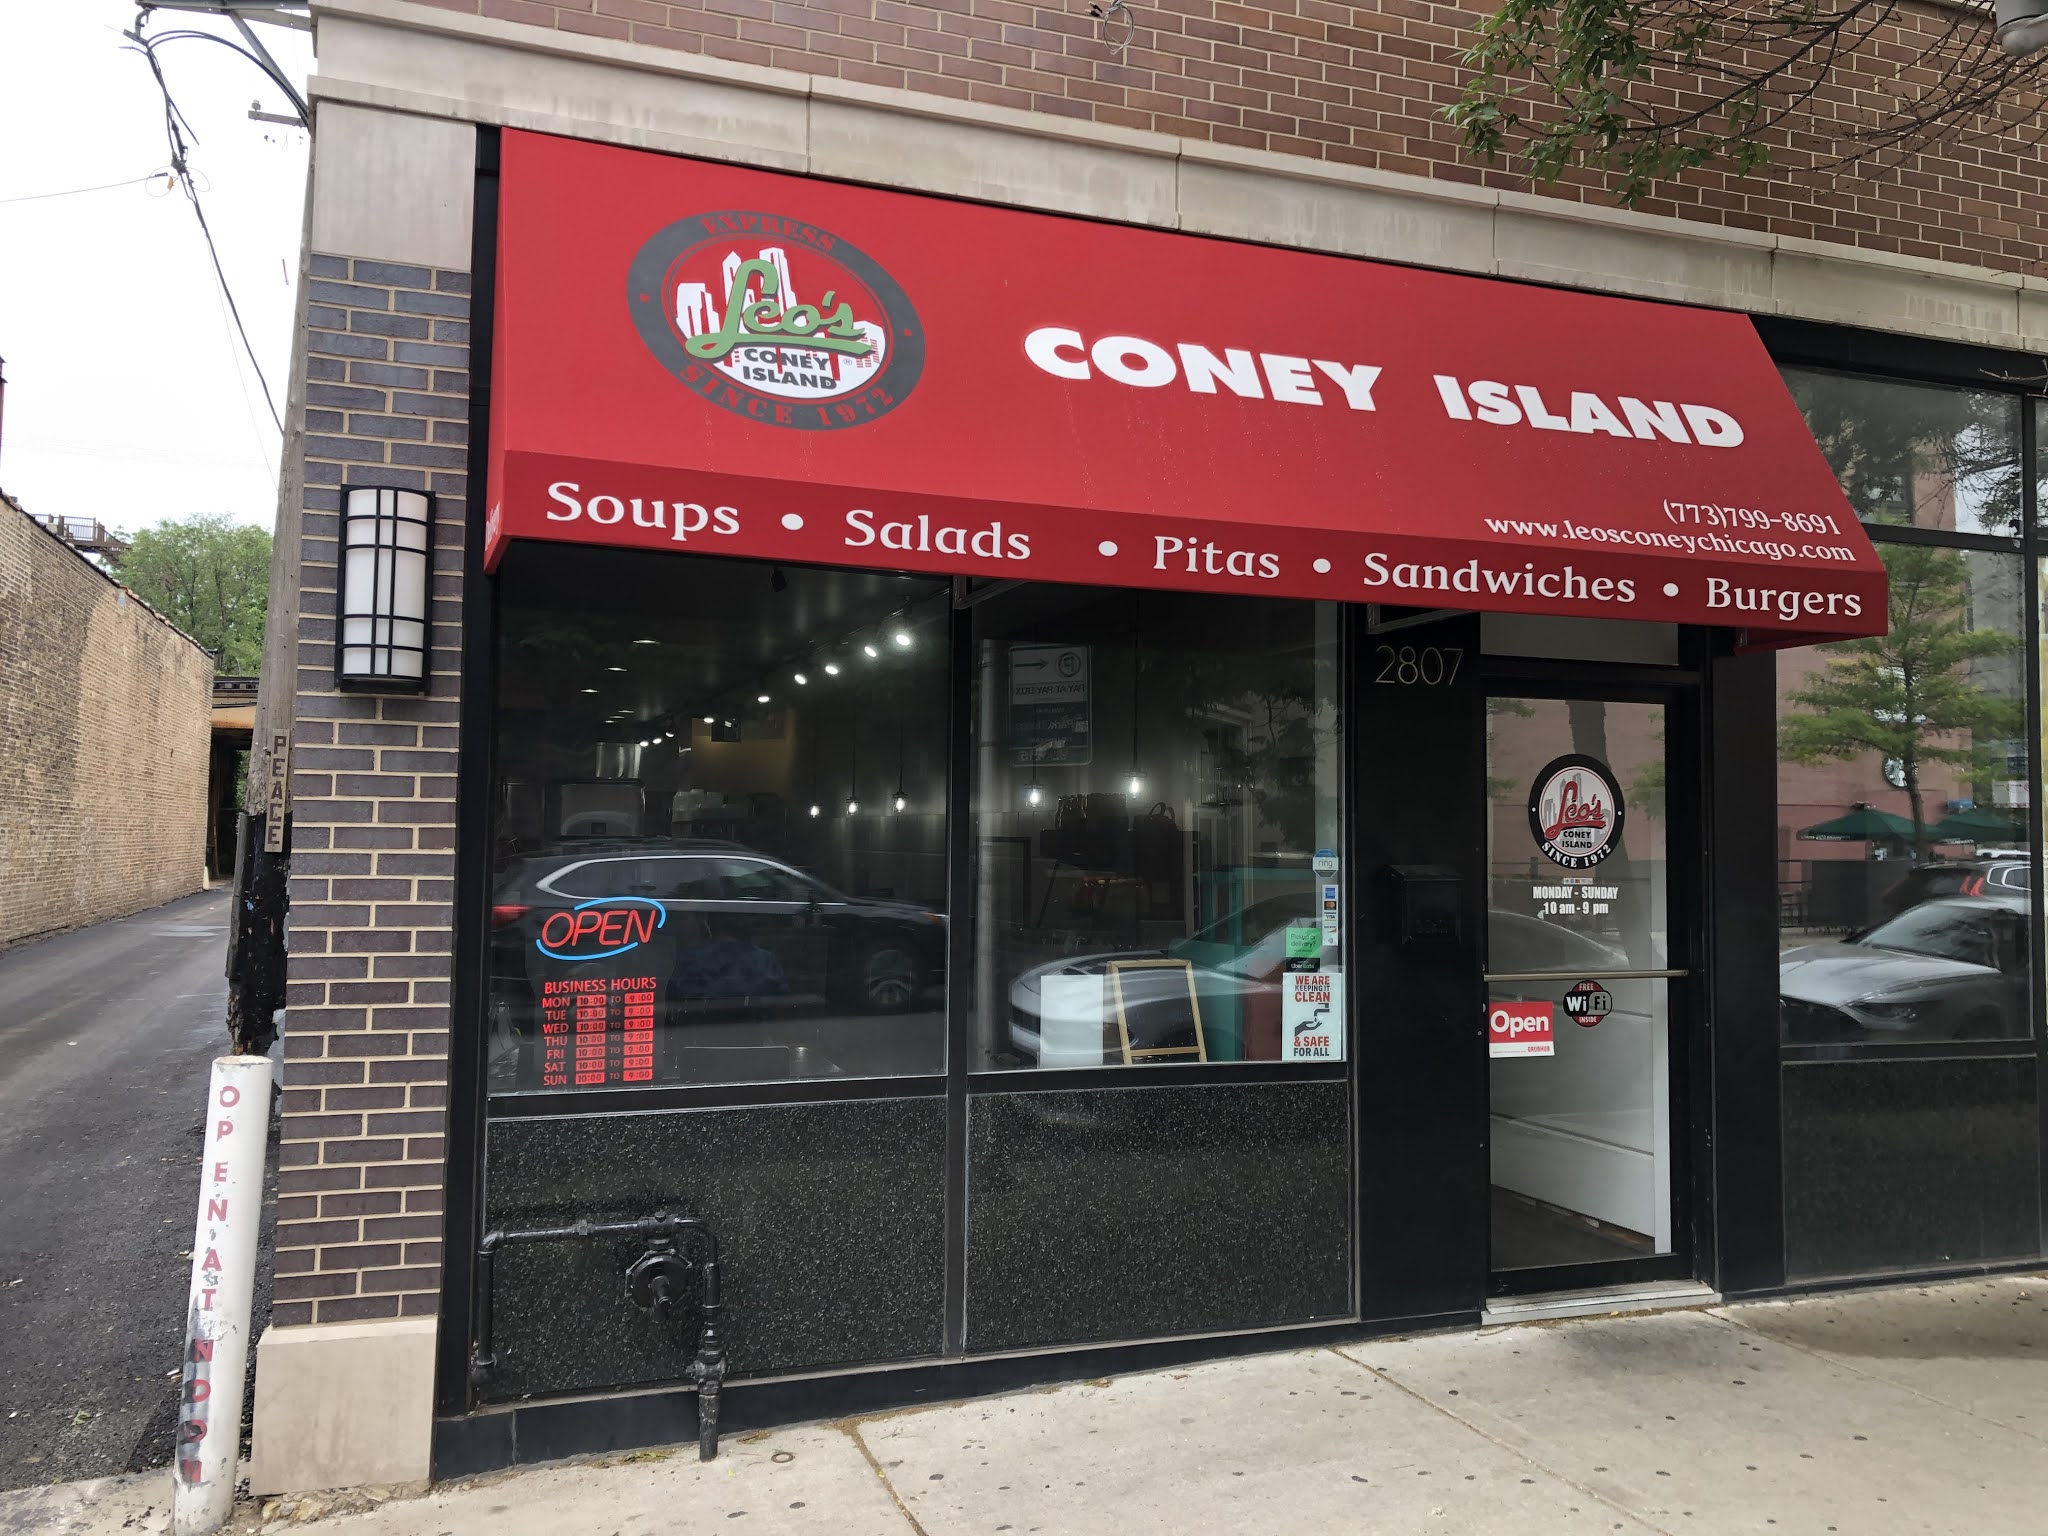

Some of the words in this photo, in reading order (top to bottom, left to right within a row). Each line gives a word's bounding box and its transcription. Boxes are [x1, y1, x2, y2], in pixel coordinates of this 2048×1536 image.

[700, 213, 836, 250] EXPRESS
[685, 258, 877, 359] Leo's
[743, 348, 829, 371] CONEY
[742, 366, 837, 390] ISLAND
[679, 363, 794, 424] SINCE
[817, 388, 895, 427] 1972
[1024, 327, 1383, 411] CONEY
[1433, 374, 1745, 449] ISLAND
[1662, 498, 1842, 536] (773)799-8691
[1484, 516, 1857, 562] www.leosconeychicago.com
[546, 481, 741, 541] Soups
[844, 508, 1031, 560] Salads
[1152, 535, 1281, 580] Pitas
[1363, 551, 1636, 604] Sandwiches
[1706, 577, 1863, 621] Burgers
[1375, 645, 1464, 686] 2807
[268, 735, 286, 845] PEACE
[1544, 780, 1606, 840] Leo's
[1562, 830, 1591, 839] CONEY
[1561, 839, 1593, 849] ISLAND
[1541, 841, 1578, 868] SINCE
[1583, 844, 1612, 867] 1972
[1318, 858, 1333, 869] ring
[1533, 886, 1573, 899] MONDAY
[1581, 886, 1619, 899] SUNDAY
[1543, 901, 1557, 914] 10
[1559, 903, 1575, 914] am
[1582, 901, 1589, 914] 9
[1592, 903, 1609, 915] pm
[542, 910, 656, 948] OPEN
[544, 979, 606, 994] BUSINESS
[611, 977, 657, 990] HOURS
[1295, 976, 1310, 985] WE
[1312, 976, 1330, 985] ARE
[1578, 982, 1594, 991] FREE
[542, 997, 571, 1008] MON
[579, 996, 604, 1005] 10:00
[610, 995, 621, 1003] TO
[1295, 992, 1330, 1003] CLEAN
[545, 1010, 567, 1021] TUE
[579, 1010, 604, 1018] 10:00
[610, 1008, 621, 1016] TO
[1578, 1015, 1598, 1023] INSIDE
[543, 1023, 569, 1034] WED
[579, 1022, 604, 1031] 10:00
[1490, 1010, 1549, 1038] Open
[544, 1036, 568, 1047] THU
[579, 1035, 603, 1044] 10:00
[1294, 1036, 1301, 1047] &
[1303, 1036, 1330, 1046] SAFE
[546, 1049, 565, 1060] FRI
[578, 1048, 603, 1056] 10:00
[1294, 1048, 1311, 1057] FOR
[1312, 1047, 1330, 1056] ALL
[544, 1062, 566, 1073] SAT
[578, 1061, 603, 1069] 10:00
[543, 1075, 567, 1086] SUN
[578, 1074, 601, 1082] 10:00
[207, 1085, 240, 1222] OPEN
[201, 1248, 223, 1312] AT
